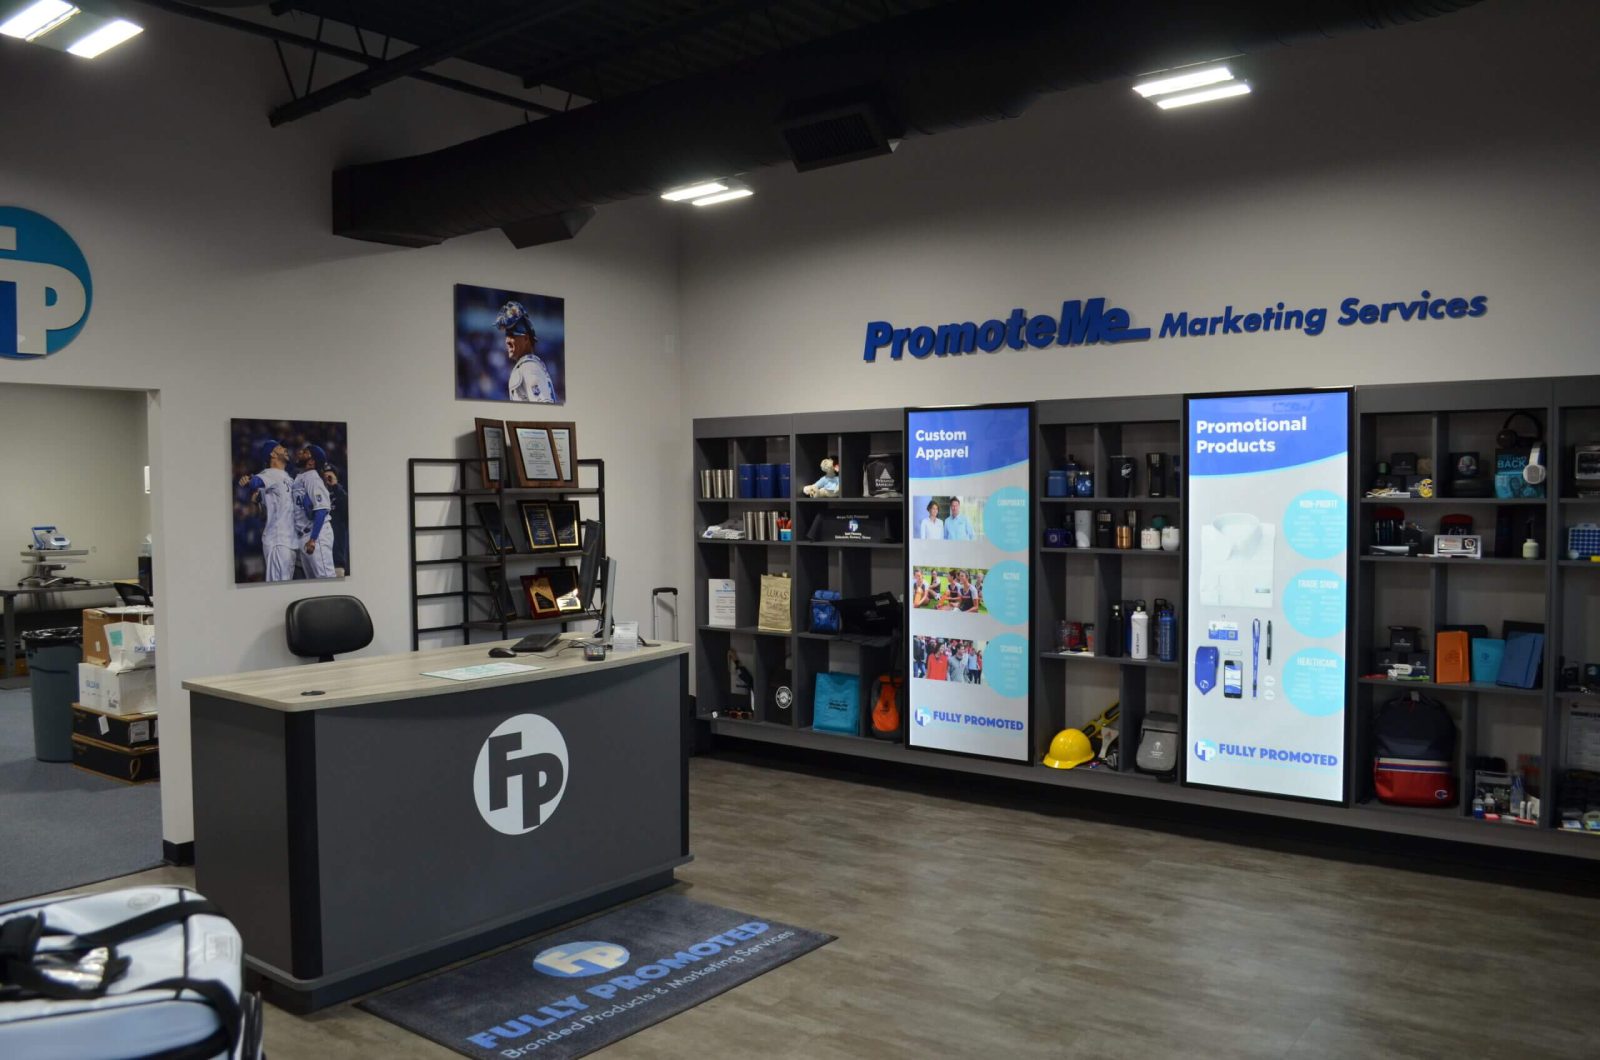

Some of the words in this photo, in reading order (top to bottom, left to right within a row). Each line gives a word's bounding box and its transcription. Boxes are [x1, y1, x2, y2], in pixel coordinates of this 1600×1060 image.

[863, 298, 1151, 362] PromoteMe
[1160, 302, 1328, 337] Marketing
[1337, 290, 1488, 326] Services
[915, 429, 967, 442] Custom
[1196, 416, 1307, 434] Promotional
[915, 446, 969, 460] Apparel
[1196, 438, 1276, 454] Products
[933, 710, 962, 724] FULLY
[963, 714, 1025, 731] PROMOTED
[1218, 743, 1256, 758] FULLY
[1259, 748, 1339, 767] PROMOTED
[487, 730, 564, 830] FP
[465, 994, 590, 1049] FULLY
[585, 921, 770, 1000] PROMOTED
[500, 1021, 587, 1060] Branded
[581, 989, 656, 1025] Products
[653, 986, 669, 997] &
[670, 955, 745, 989] Marketing
[734, 930, 796, 957] Services
